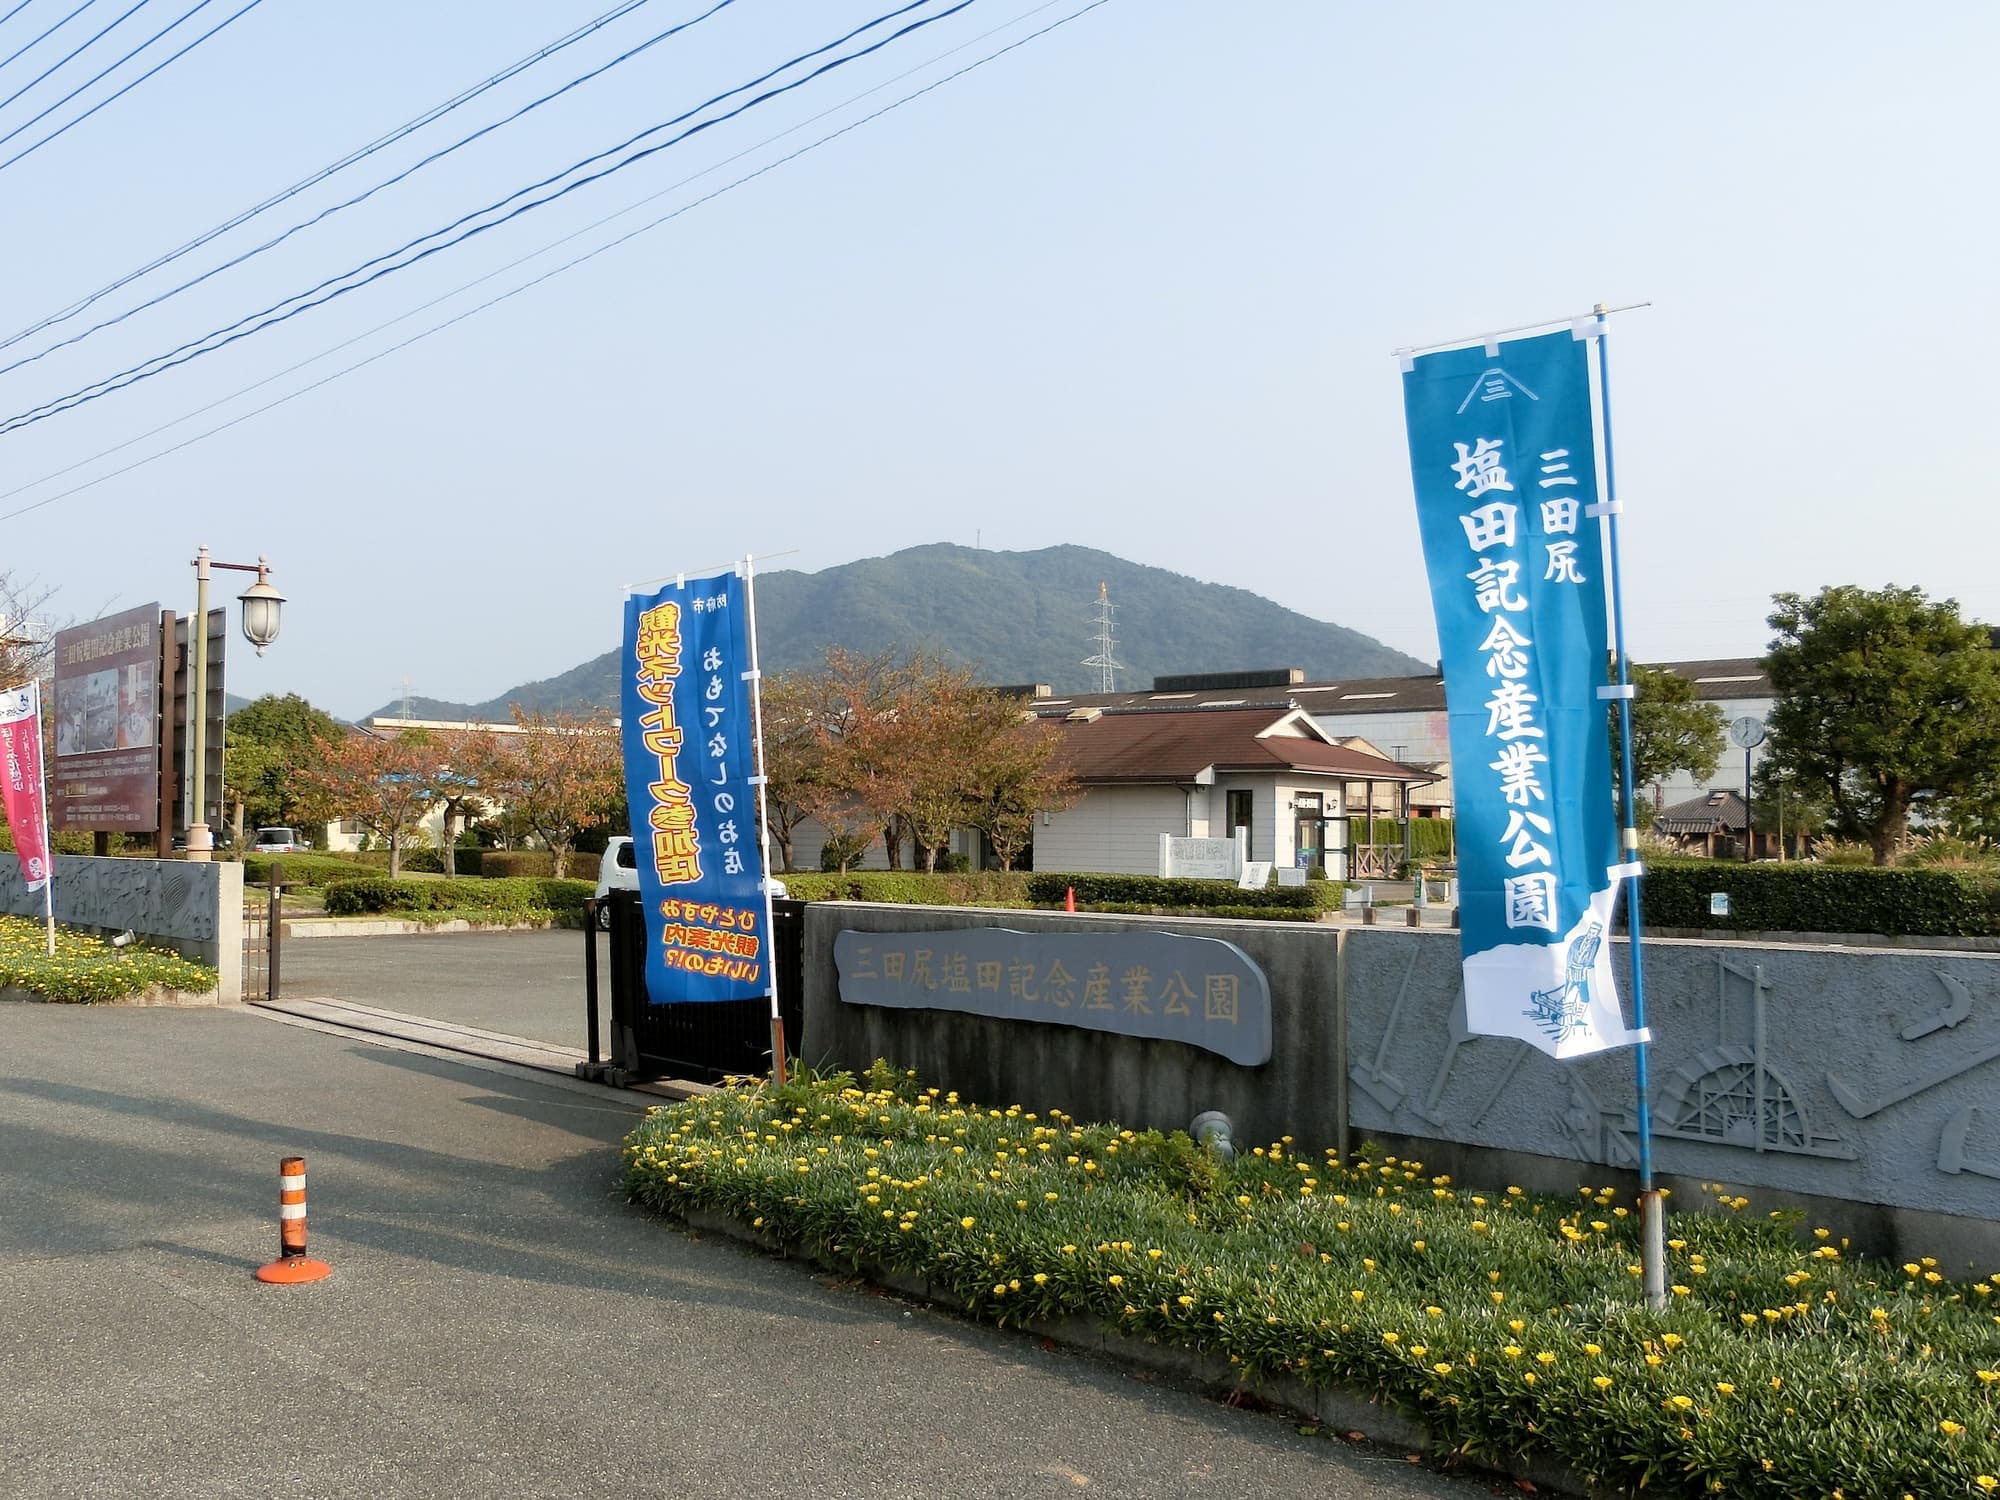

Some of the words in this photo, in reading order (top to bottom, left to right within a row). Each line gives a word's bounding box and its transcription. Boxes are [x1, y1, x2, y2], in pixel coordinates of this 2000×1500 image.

[1538, 449, 1586, 585] 三田尻
[1451, 438, 1560, 932] 塩田記念産業公園
[850, 946, 1241, 1025] 三田尻塩田記念産業公園
